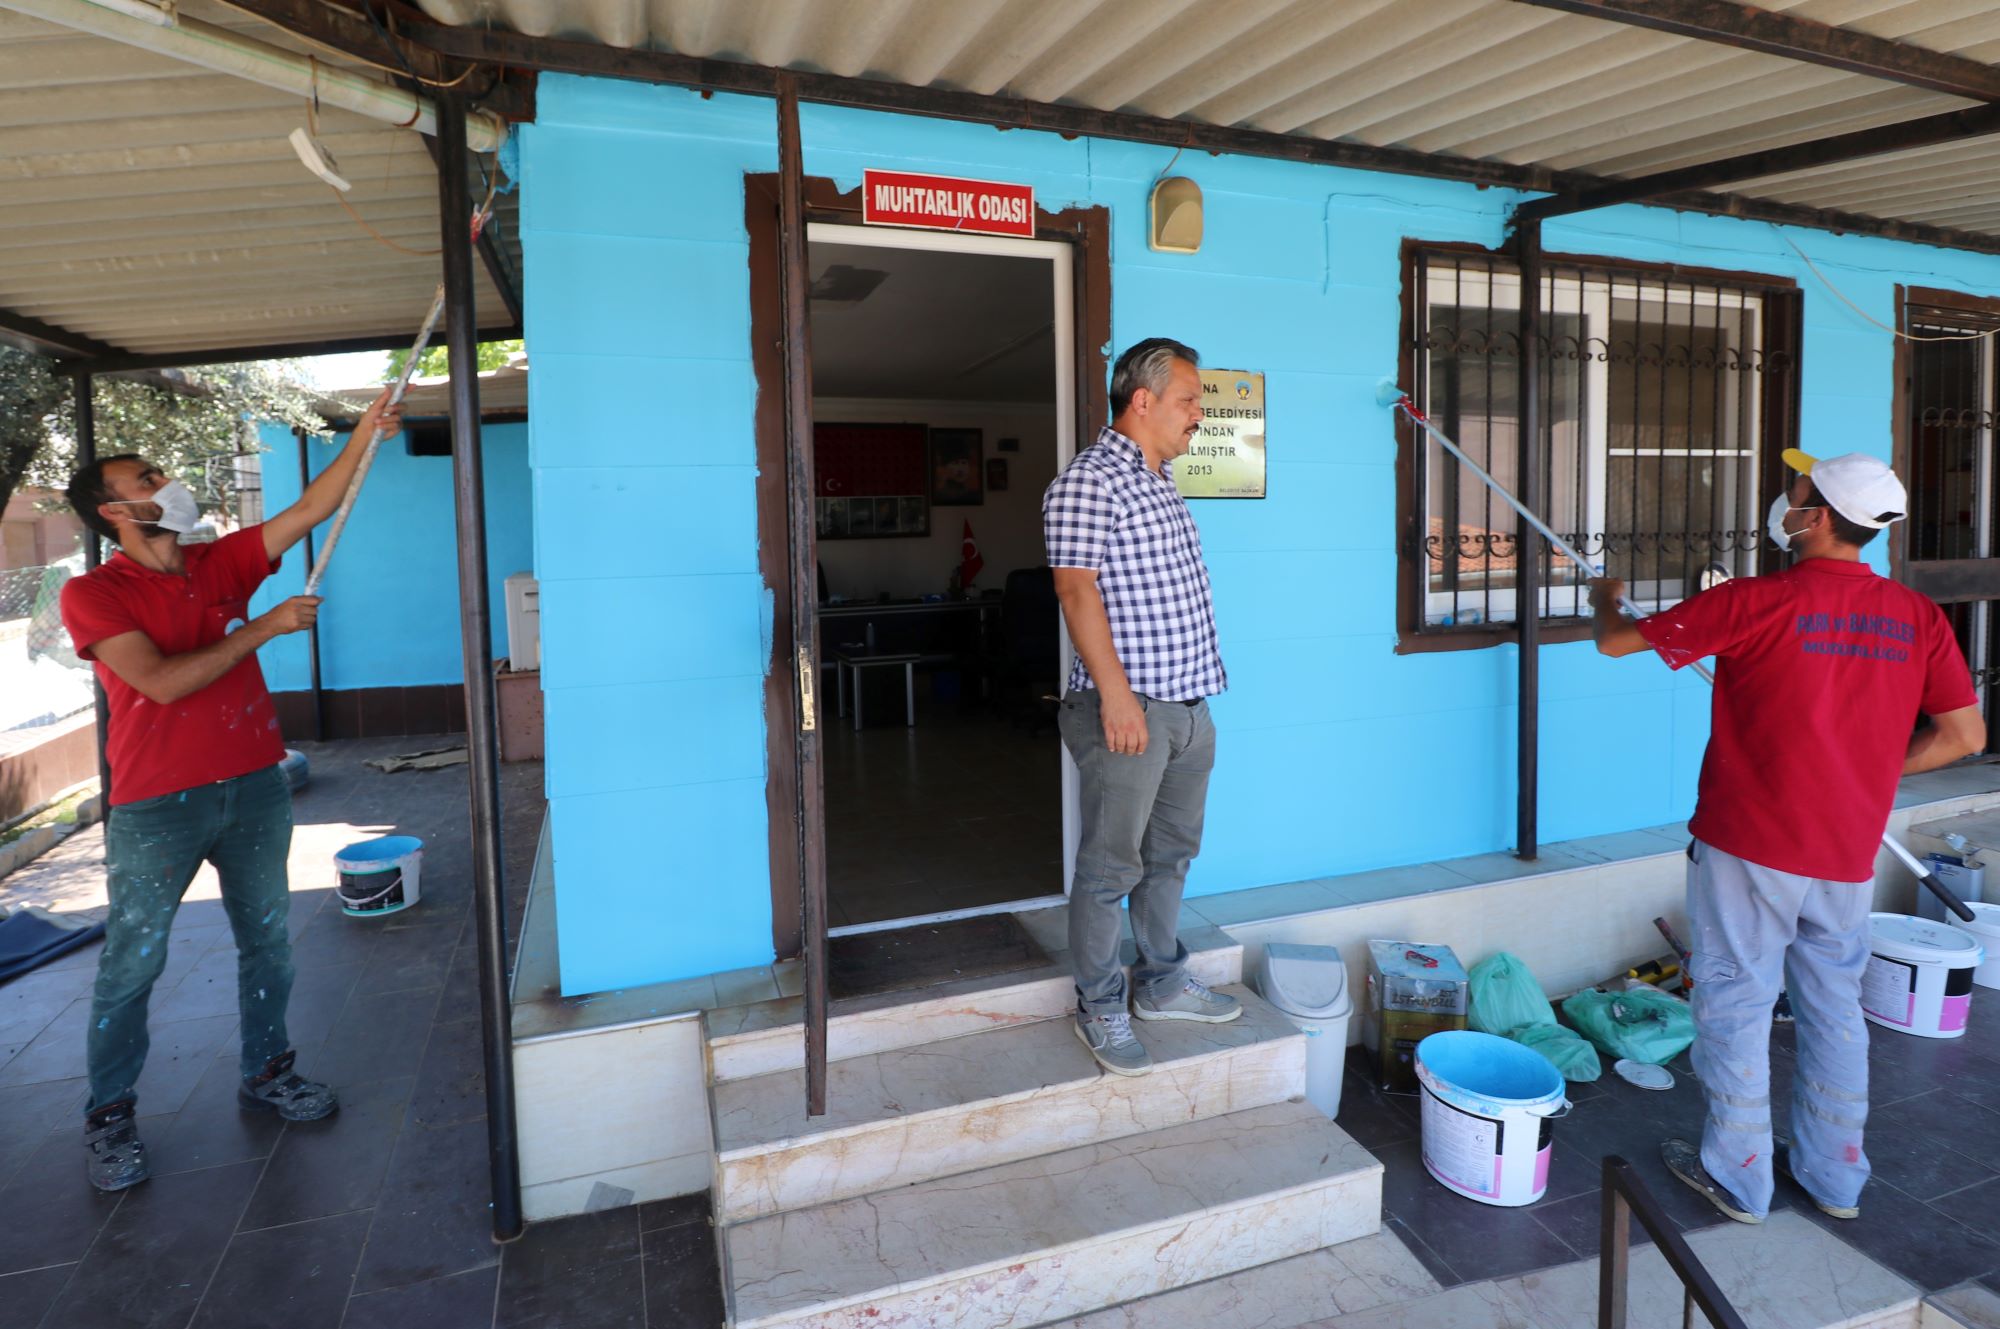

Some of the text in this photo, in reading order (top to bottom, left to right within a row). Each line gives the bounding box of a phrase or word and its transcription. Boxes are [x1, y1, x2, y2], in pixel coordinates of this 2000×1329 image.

[875, 184, 1027, 224] MUHTARLIK ODASI
[1194, 426, 1235, 438] INDAN
[1187, 446, 1236, 459] ILMIŞTIR
[1187, 465, 1212, 475] 2013
[1796, 613, 1829, 635] PARK
